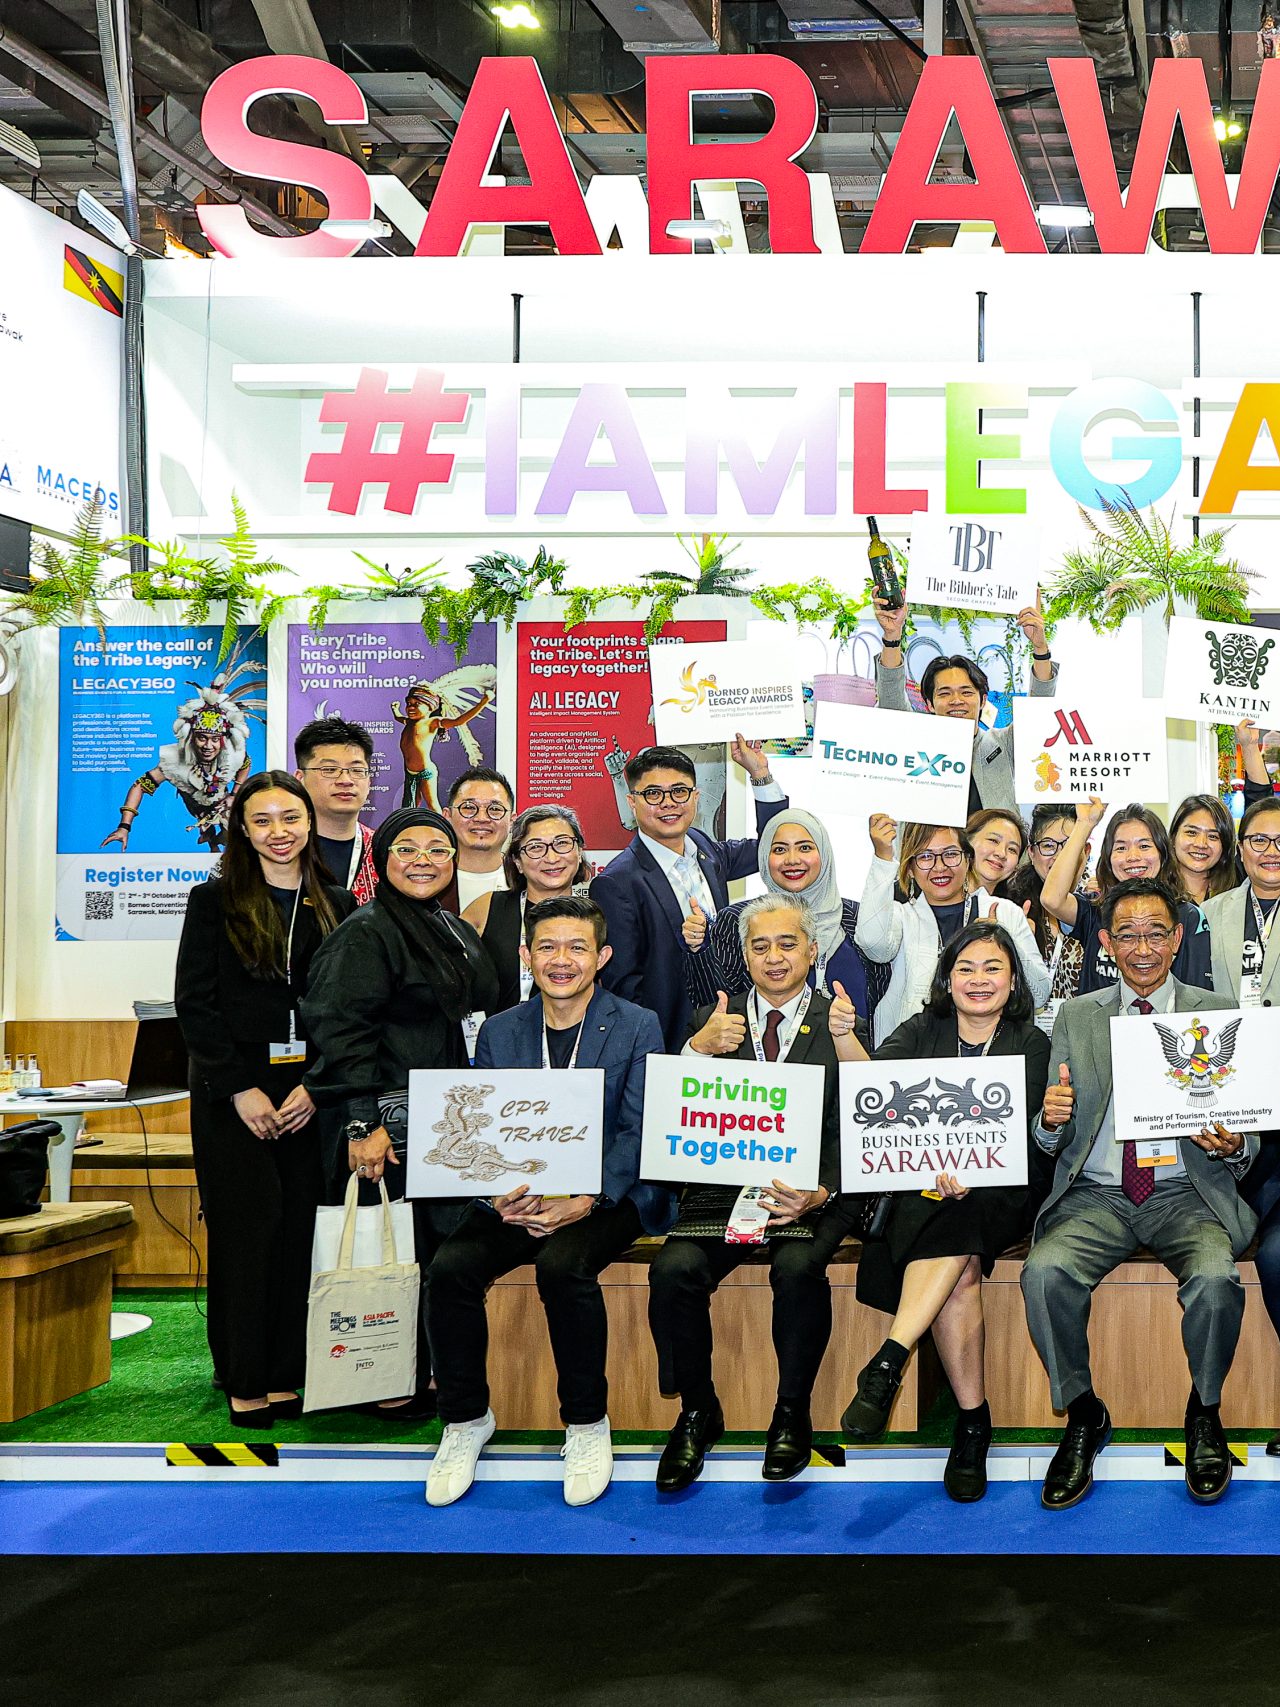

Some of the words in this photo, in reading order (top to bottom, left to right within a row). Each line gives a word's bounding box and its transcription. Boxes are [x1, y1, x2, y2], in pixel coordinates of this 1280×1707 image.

[38, 465, 118, 511] MACEOS
[926, 577, 946, 592] The
[949, 579, 993, 597] Bibber's
[996, 584, 1018, 600] Tale
[73, 640, 134, 652] Answer
[136, 640, 162, 652] the
[165, 639, 194, 652] call
[197, 638, 213, 651] of
[300, 634, 344, 650] Every
[347, 633, 387, 646] Tribe
[530, 636, 564, 647] Your
[566, 635, 638, 650] footprints
[73, 654, 99, 666] the
[102, 653, 142, 666] Tribe
[145, 654, 207, 669] Legacy.
[301, 648, 330, 660] has
[332, 647, 426, 664] champions.
[530, 650, 554, 660] the
[556, 650, 597, 660] Tribe.
[600, 650, 633, 660] Let's
[300, 662, 337, 674] Who
[339, 662, 366, 674] will
[530, 663, 578, 677] legacy
[581, 663, 649, 677] together!
[72, 677, 176, 690] LEGACY360
[300, 679, 330, 692] you
[332, 675, 417, 688] nominate?
[708, 688, 749, 698] BORNEO
[752, 686, 793, 694] INSPIRES
[708, 696, 747, 706] LEGACY
[750, 694, 794, 704] AWARDS
[530, 692, 552, 709] AI.
[555, 692, 620, 709] LEGACY
[1199, 692, 1270, 712] KANTIN
[904, 751, 966, 776] EXPO
[1070, 752, 1152, 762] MARRIOTT
[1070, 768, 1131, 777] RESORT
[1070, 783, 1104, 792] MIRI
[85, 866, 164, 887] Register
[168, 868, 209, 882] Now
[681, 1076, 787, 1111] Driving
[500, 1101, 550, 1118] CPH
[1134, 1114, 1164, 1122] Ministry
[1174, 1112, 1208, 1120] Tourism,
[1210, 1110, 1240, 1118] Creative
[1242, 1108, 1272, 1116] Industry
[680, 1106, 785, 1136] Impact
[1166, 1122, 1207, 1130] Performing
[1226, 1118, 1258, 1126] Sarawak
[500, 1126, 589, 1142] TRAVEL
[861, 1132, 940, 1150] BUSINESS
[946, 1130, 1007, 1146] EVENTS
[666, 1134, 797, 1166] Together
[861, 1146, 1006, 1175] SARAWAK
